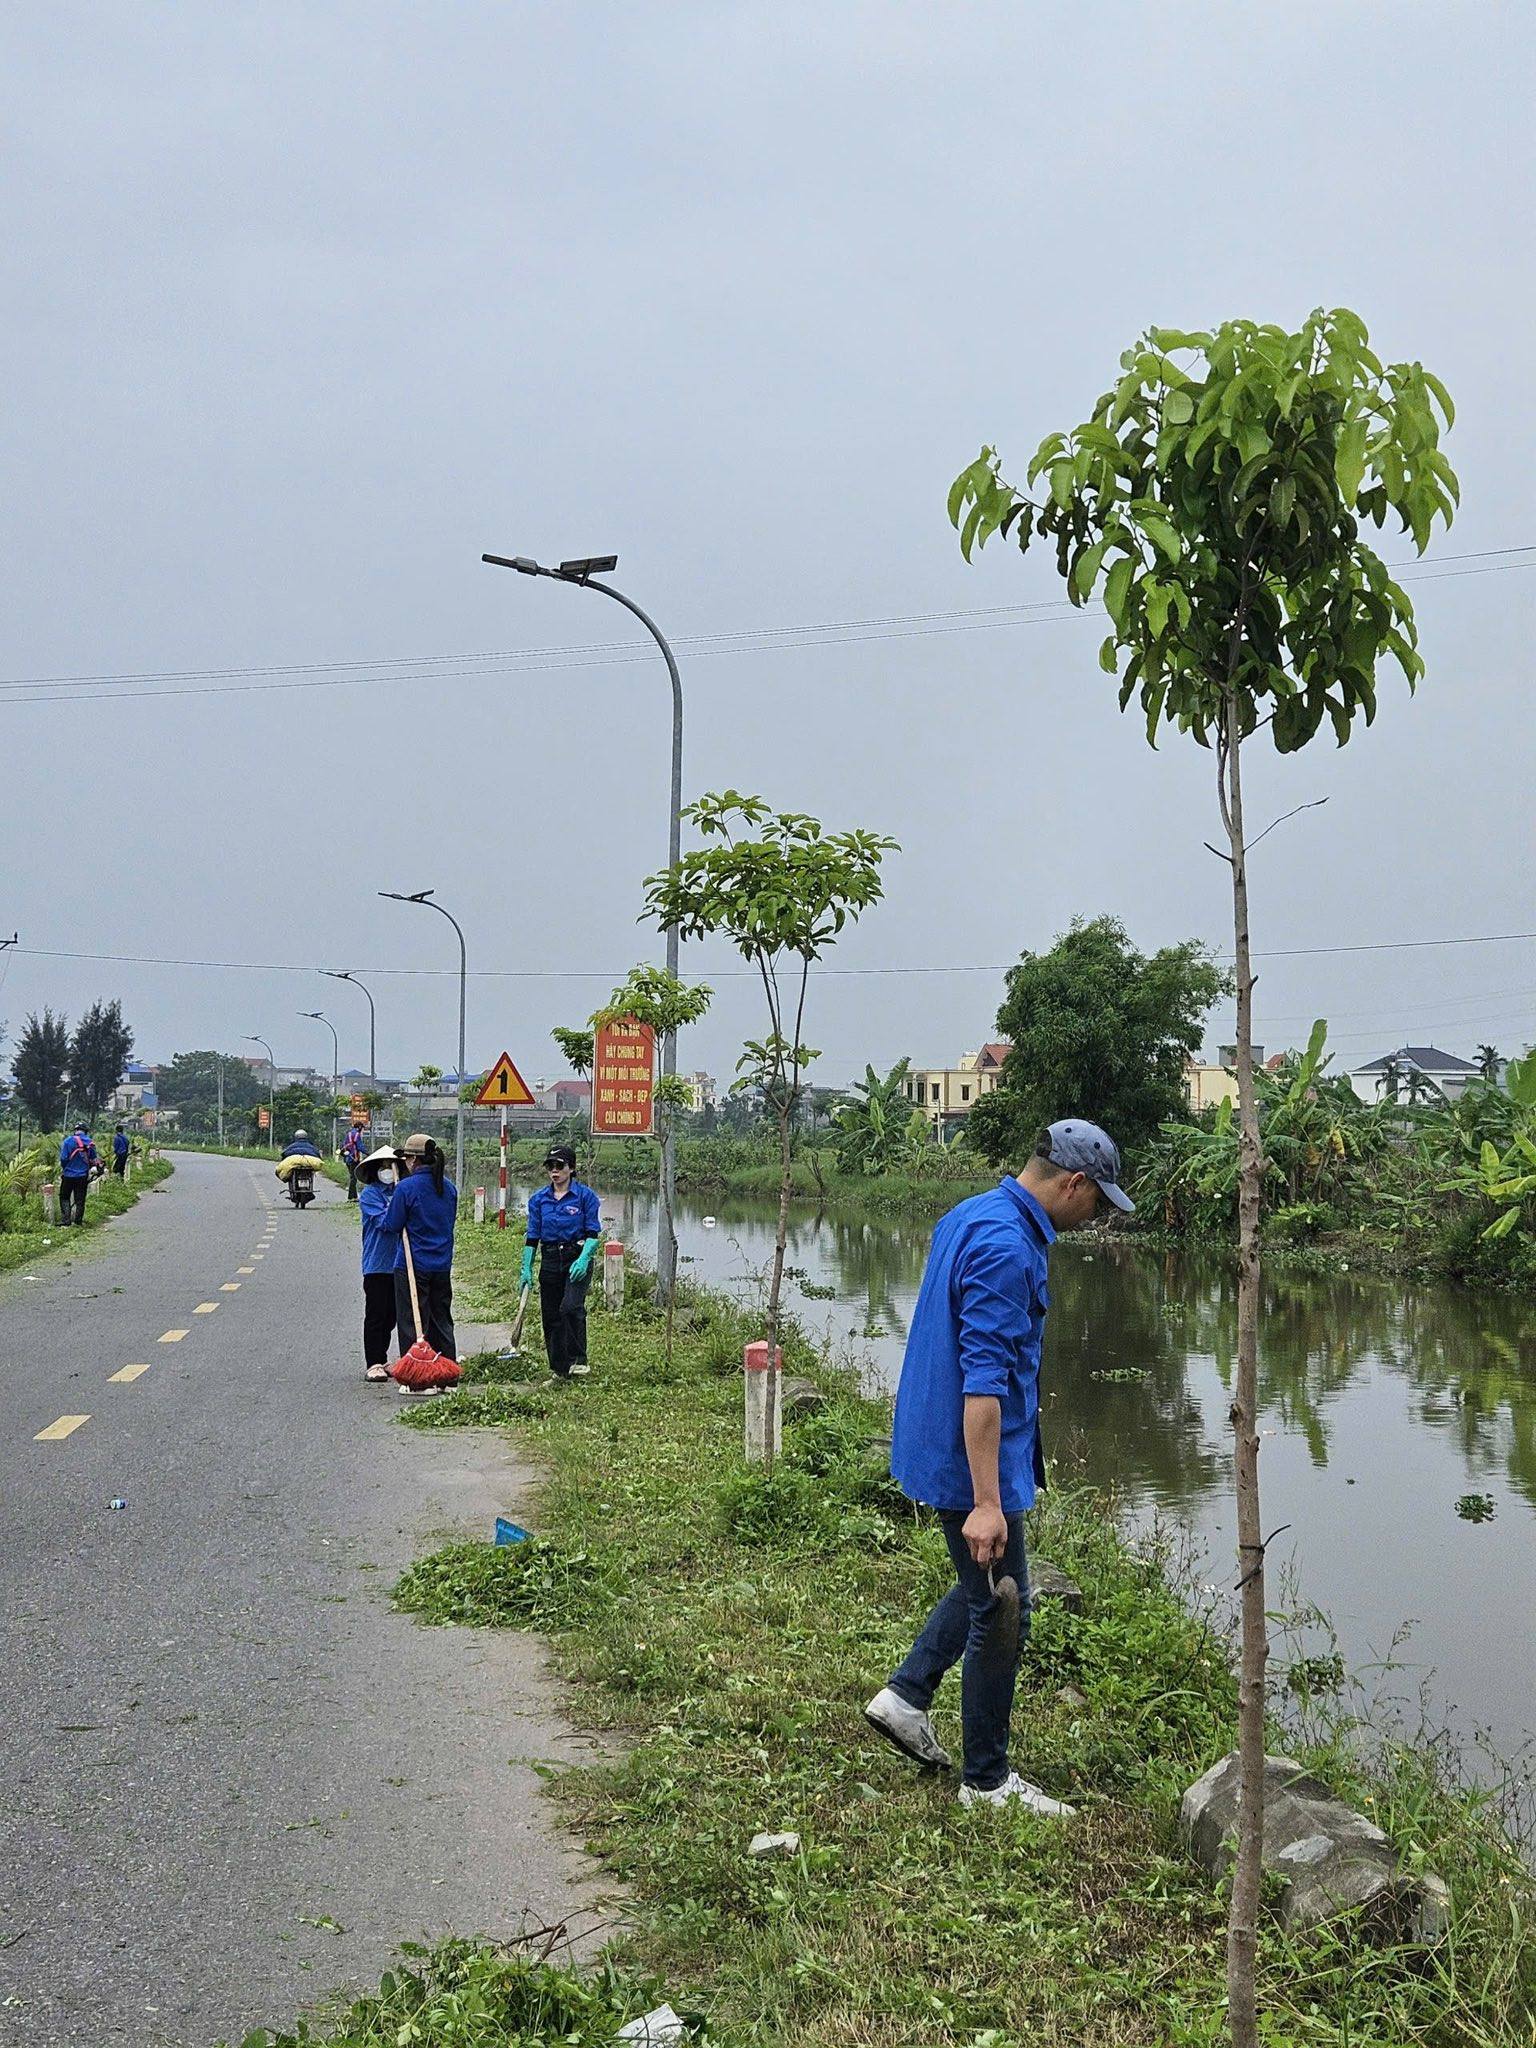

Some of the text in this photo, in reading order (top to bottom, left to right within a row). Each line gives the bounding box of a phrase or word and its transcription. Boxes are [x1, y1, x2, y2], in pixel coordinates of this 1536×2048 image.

[600, 1089, 615, 1102] XANH
[619, 1089, 633, 1106] SẠCH
[637, 1089, 648, 1106] ĐẸP
